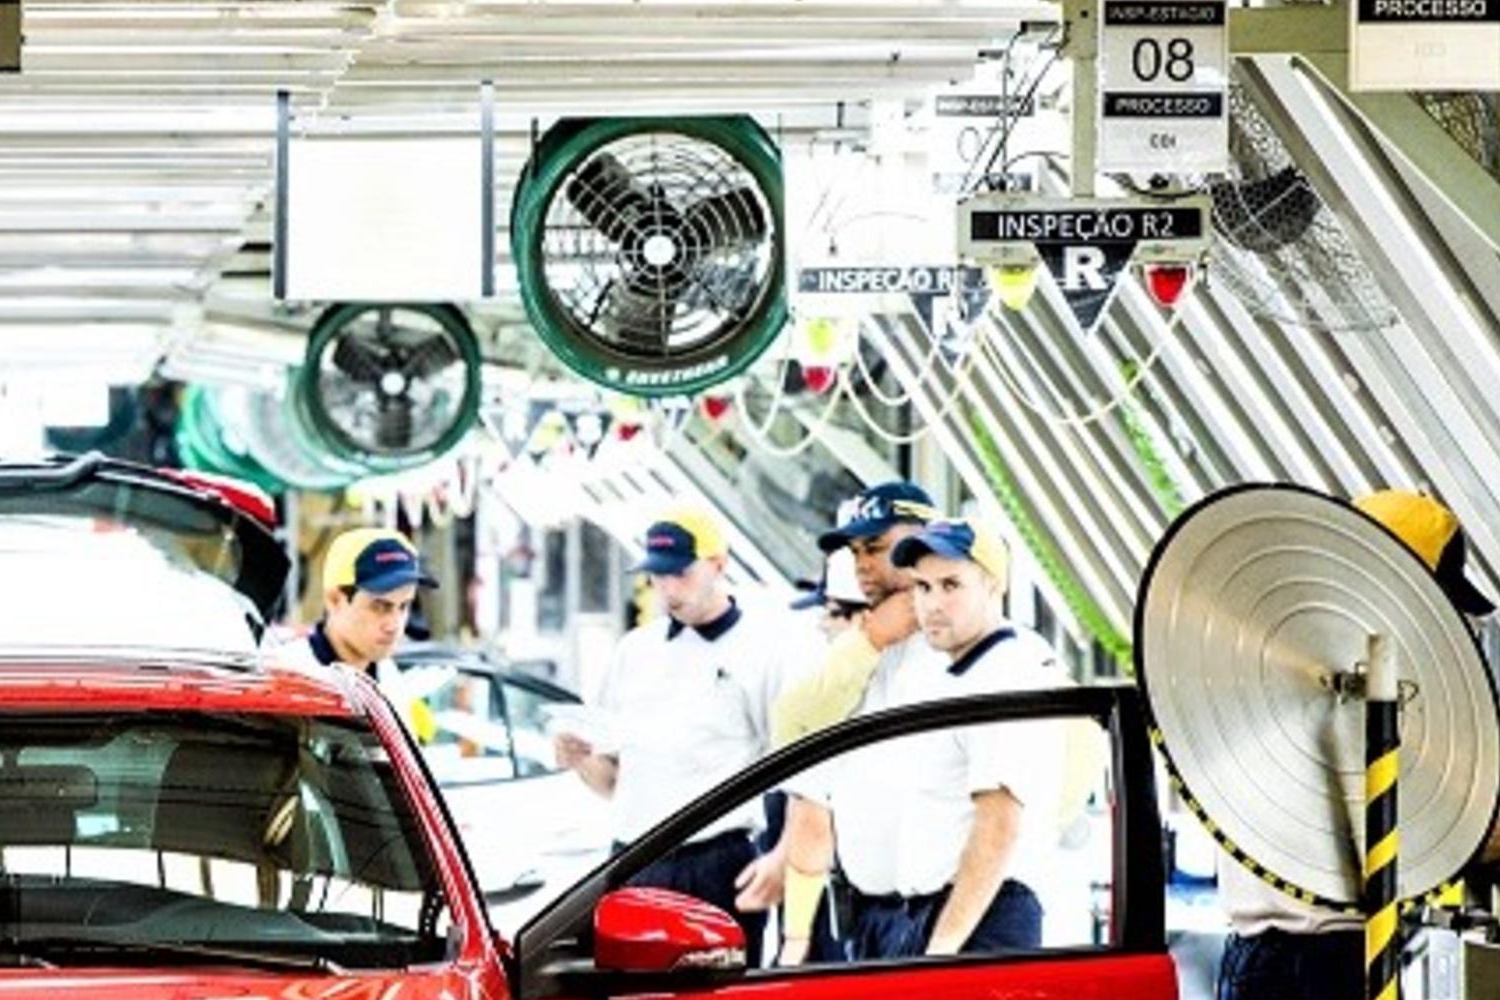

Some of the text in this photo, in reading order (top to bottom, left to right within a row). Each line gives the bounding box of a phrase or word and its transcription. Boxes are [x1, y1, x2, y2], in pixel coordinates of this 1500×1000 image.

[1373, 0, 1488, 16] PROCESSO
[1132, 37, 1194, 82] 08
[998, 208, 1174, 241] INSPEÇÃO R2
[1062, 246, 1108, 291] R
